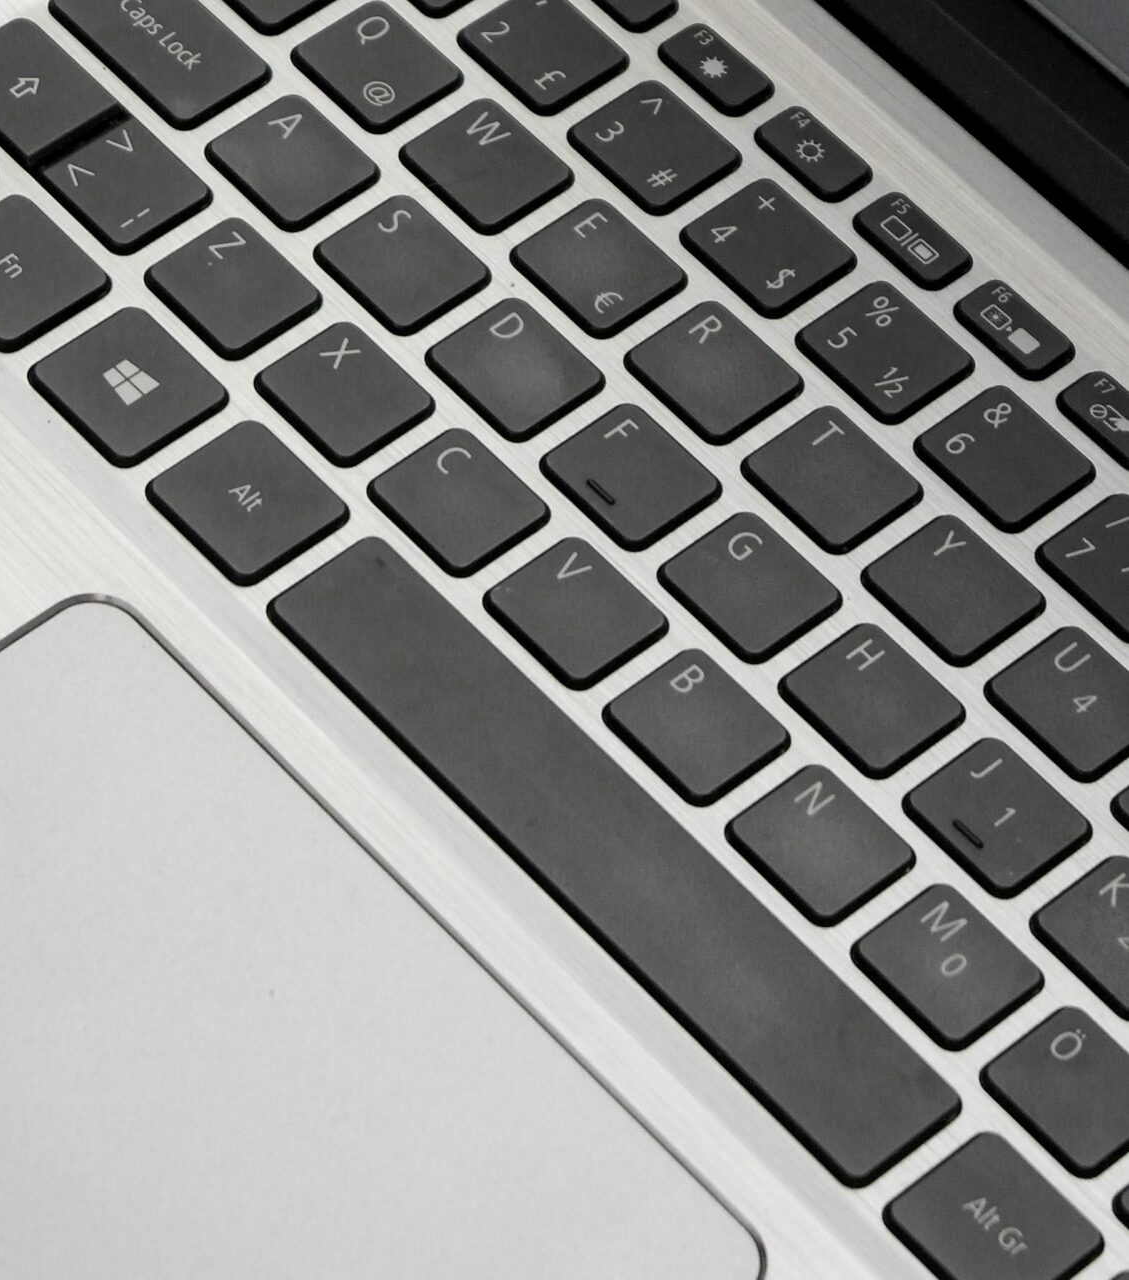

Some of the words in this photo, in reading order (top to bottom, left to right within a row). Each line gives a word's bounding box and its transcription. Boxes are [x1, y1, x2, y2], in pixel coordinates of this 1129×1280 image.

[356, 15, 390, 45] Q
[480, 20, 510, 44] 2
[693, 29, 714, 46] F3
[158, 31, 202, 71] Lock
[362, 80, 396, 107] @
[533, 70, 567, 91] £
[267, 113, 303, 140] A
[465, 111, 512, 146] W
[594, 120, 625, 143] 3
[789, 111, 811, 129] F4
[646, 168, 678, 188] #
[890, 198, 911, 215] F5
[377, 209, 412, 233] S
[573, 211, 609, 239] E
[710, 225, 738, 244] 4
[208, 230, 247, 260] Z
[765, 268, 796, 289] $
[594, 291, 624, 314] €
[992, 286, 1013, 303] F6
[489, 311, 525, 339] D
[864, 295, 900, 328] %
[688, 314, 723, 345] R
[826, 326, 858, 350] 5
[319, 337, 362, 370] X
[1093, 377, 1116, 394] F7
[603, 418, 640, 439] F
[983, 402, 1012, 429] &
[811, 420, 845, 446] T
[945, 432, 976, 455] 6
[436, 446, 472, 475] C
[227, 484, 263, 513] Alt
[727, 531, 763, 561] G
[933, 529, 967, 557] Y
[1065, 537, 1096, 559] 7
[556, 551, 593, 580] V
[845, 638, 886, 672] H
[1053, 641, 1091, 673] U
[669, 664, 705, 694] B
[1072, 695, 1098, 714] 4
[969, 758, 1003, 779] J
[793, 780, 836, 817] N
[993, 807, 1016, 827] 1
[1098, 872, 1129, 908] K
[920, 900, 968, 943] M
[1049, 1028, 1086, 1061] Ö
[962, 1197, 1001, 1231] Alt
[997, 1226, 1028, 1255] Gr
